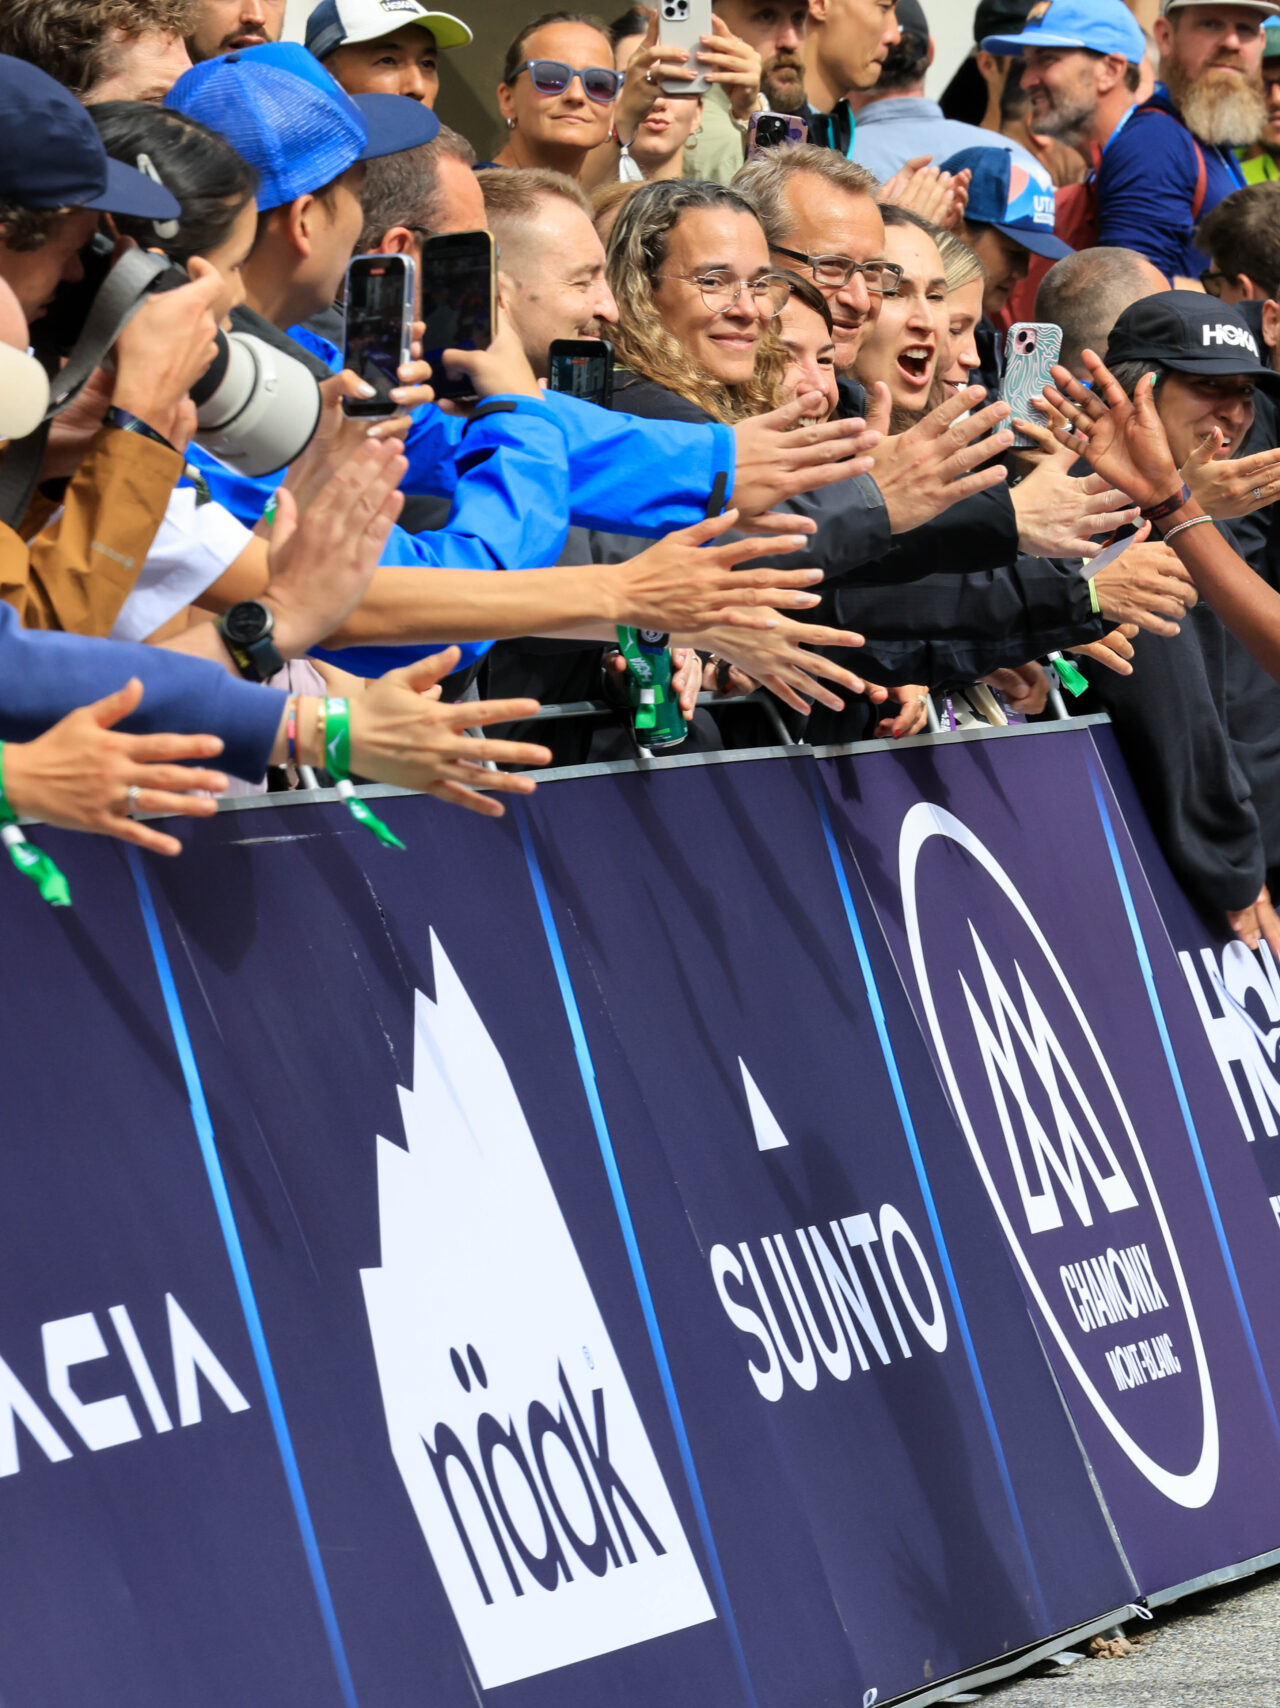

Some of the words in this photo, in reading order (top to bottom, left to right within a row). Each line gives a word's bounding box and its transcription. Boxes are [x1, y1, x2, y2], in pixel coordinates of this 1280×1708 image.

[1202, 323, 1259, 358] HOKA
[710, 1203, 948, 1402] SUUNTO
[1059, 1243, 1169, 1333] CHAMONIX
[1105, 1333, 1182, 1391] MONT-BLANC
[419, 1343, 668, 1606] näak
